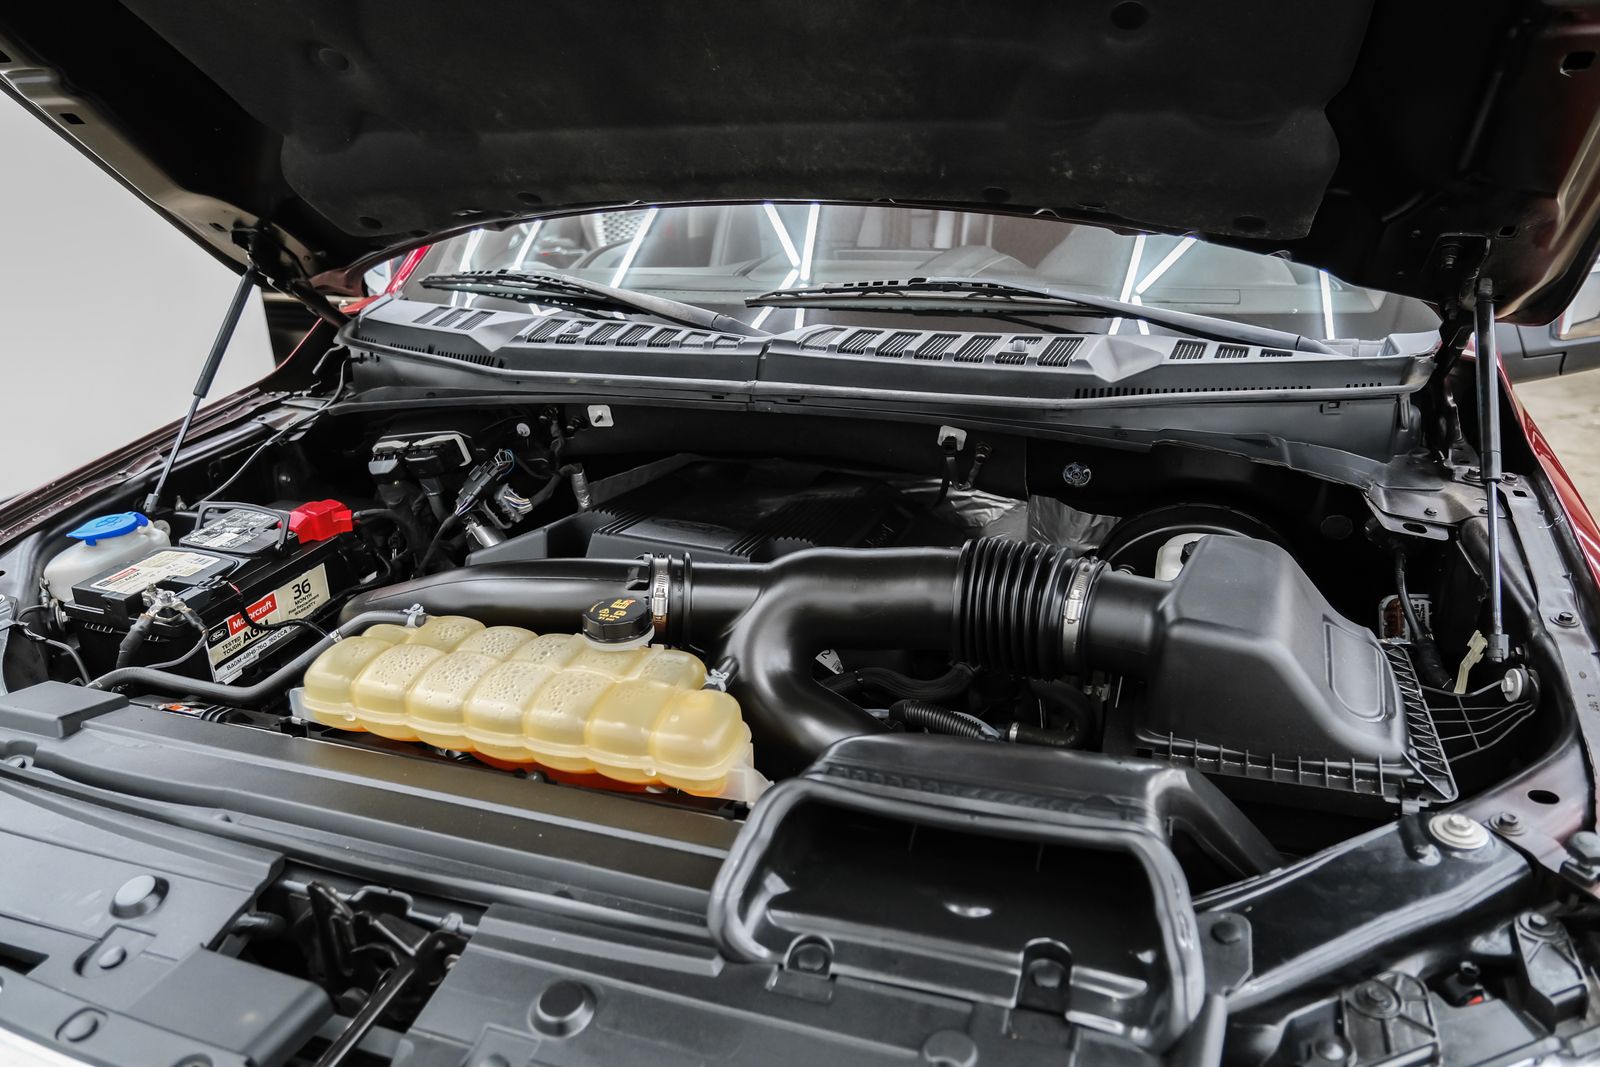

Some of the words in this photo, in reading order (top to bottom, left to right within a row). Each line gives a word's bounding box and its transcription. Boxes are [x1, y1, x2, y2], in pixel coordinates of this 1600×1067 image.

[292, 579, 311, 600] 36
[294, 593, 312, 606] MONTH
[232, 601, 272, 629] Moorcraft
[294, 601, 316, 616] WARRANTY
[277, 629, 288, 641] CCA
[222, 636, 241, 650] TESTED
